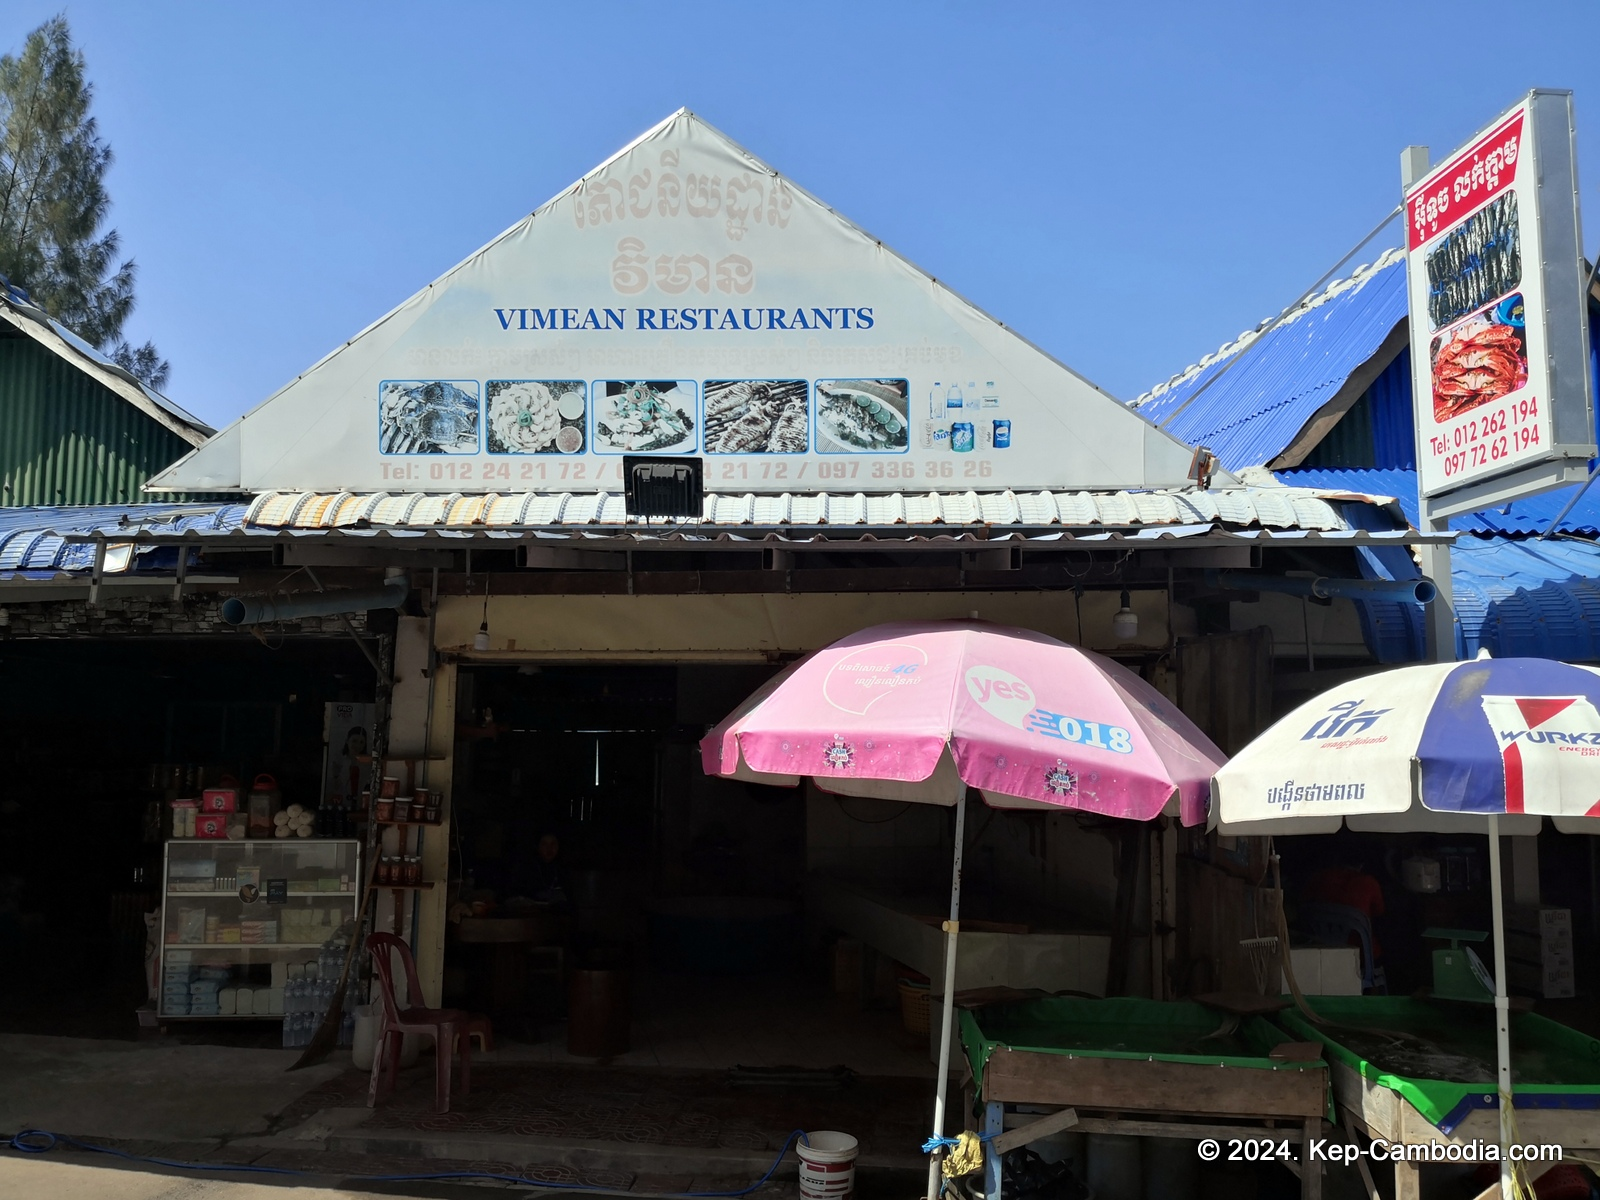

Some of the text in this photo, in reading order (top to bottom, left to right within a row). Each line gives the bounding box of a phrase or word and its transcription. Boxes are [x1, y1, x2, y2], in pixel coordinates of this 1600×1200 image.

[611, 237, 753, 294] វិមាន
[494, 307, 875, 330] VIMEAN RESTAURANTS
[1430, 396, 1538, 457] Tel: 012 262 194
[1444, 424, 1540, 477] 097 72 62 194
[380, 462, 419, 480] Tel:
[430, 462, 472, 480] 012
[482, 462, 511, 480] 24
[520, 462, 548, 480] 21
[558, 462, 585, 480] 72
[595, 462, 607, 480] /
[722, 462, 748, 480] 21
[760, 462, 788, 480] 72
[797, 462, 809, 480] /
[818, 461, 860, 480] 097
[871, 461, 915, 480] 336
[925, 461, 954, 479] 36
[963, 460, 993, 479] 26
[892, 663, 919, 675] 4G
[970, 671, 1031, 704] yes
[1057, 715, 1133, 755] 018
